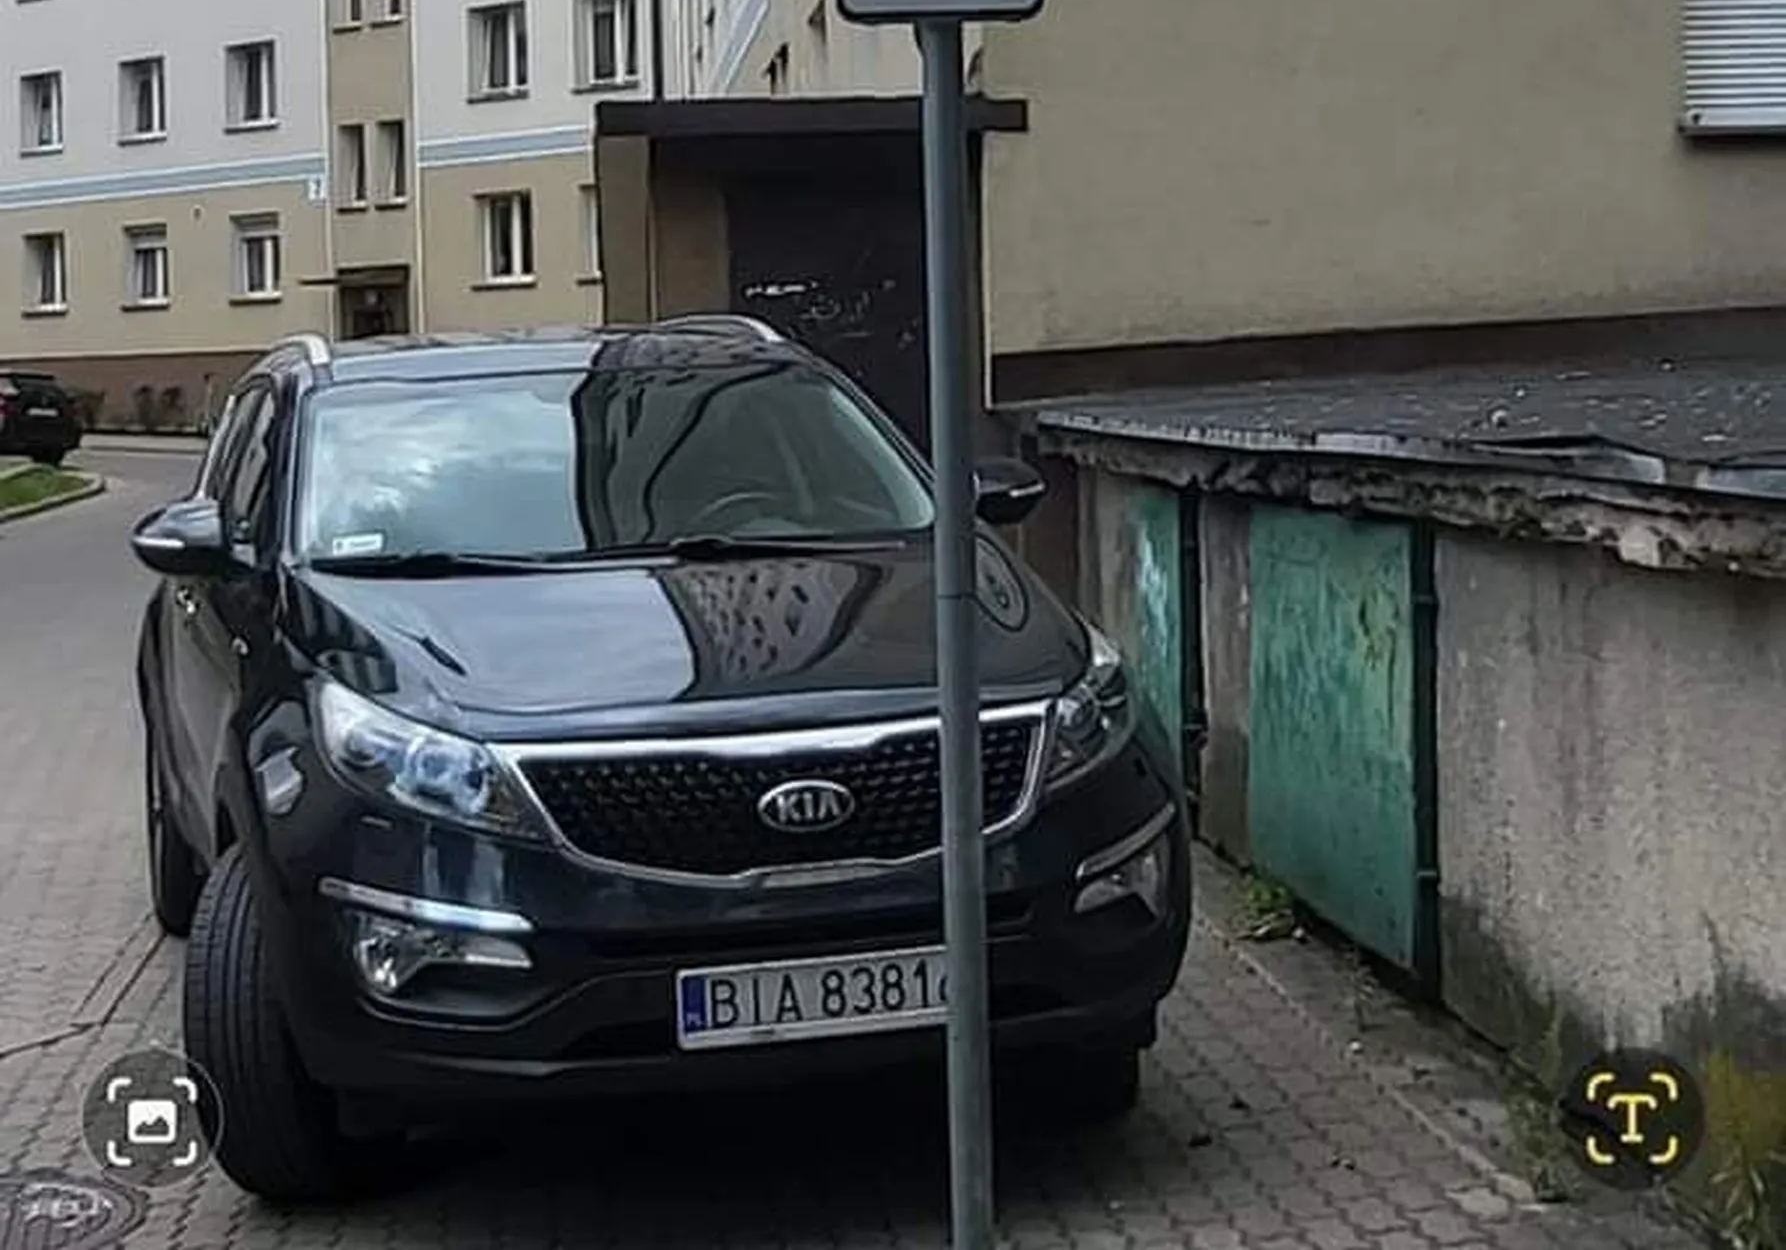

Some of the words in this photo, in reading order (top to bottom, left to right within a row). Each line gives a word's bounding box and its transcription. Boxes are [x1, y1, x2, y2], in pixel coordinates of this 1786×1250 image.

[776, 791, 841, 824] KIA
[709, 973, 804, 1029] BIA
[819, 958, 948, 1019] 8381
